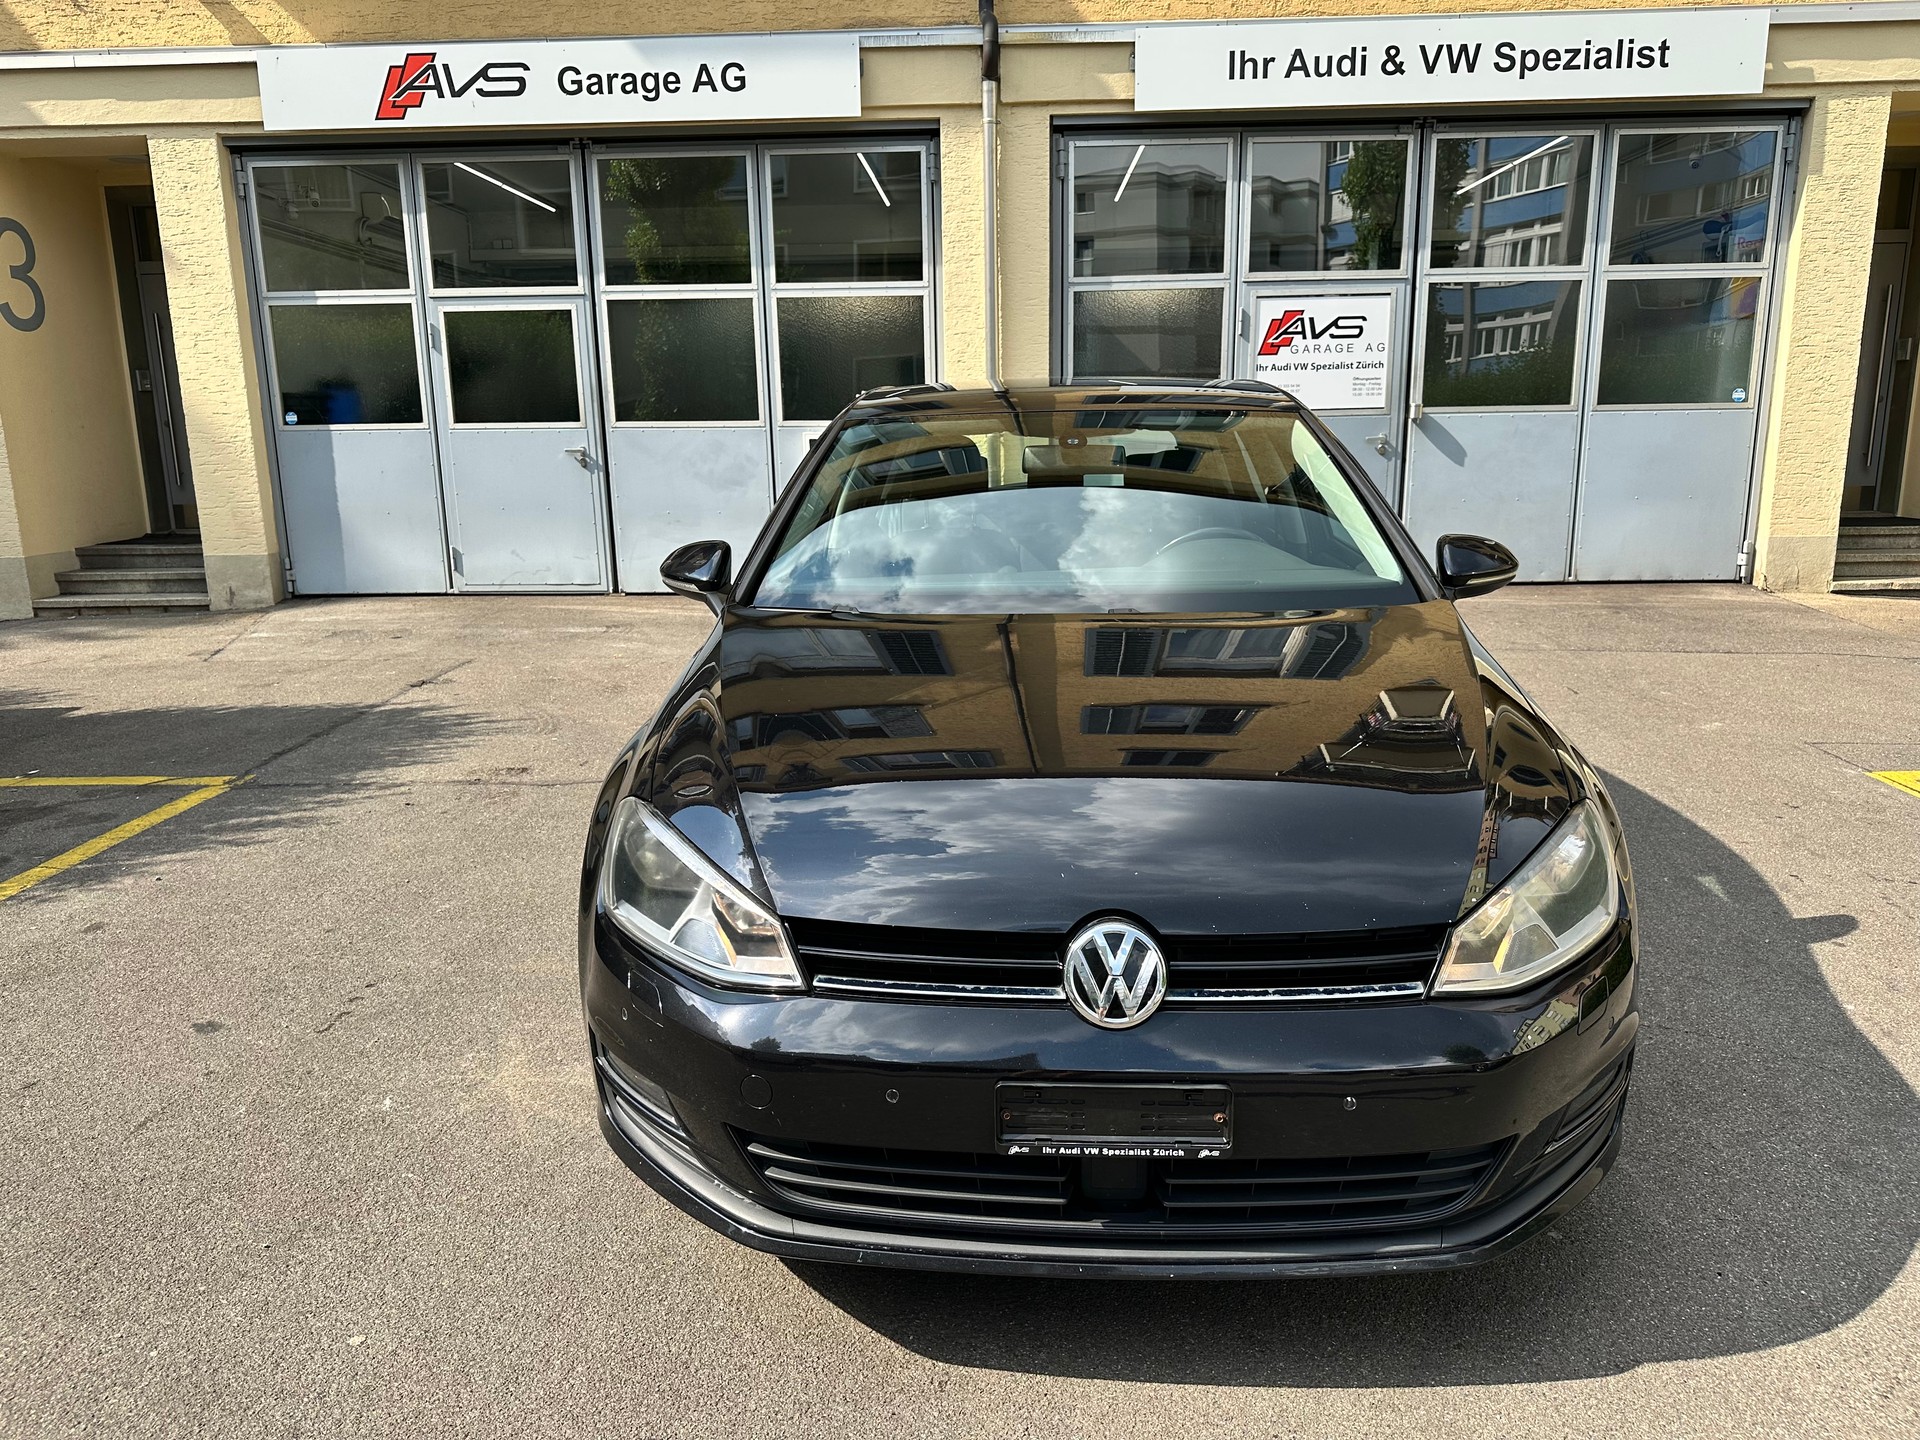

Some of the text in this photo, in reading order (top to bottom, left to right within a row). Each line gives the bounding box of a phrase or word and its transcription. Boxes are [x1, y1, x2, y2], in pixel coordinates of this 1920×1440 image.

[1227, 38, 1670, 80] Ihr Audi & VW Spezialist
[392, 61, 746, 101] AVS Garage AG
[1271, 315, 1368, 340] AVS
[1290, 342, 1386, 354] GARAGE AG
[1256, 360, 1384, 373] Ihr Audi VW Spezialist Zürich
[1066, 920, 1165, 1026] VW
[1042, 1146, 1056, 1154] Ihr
[1102, 1148, 1150, 1156] Spezialist
[1152, 1148, 1185, 1157] Zürich
